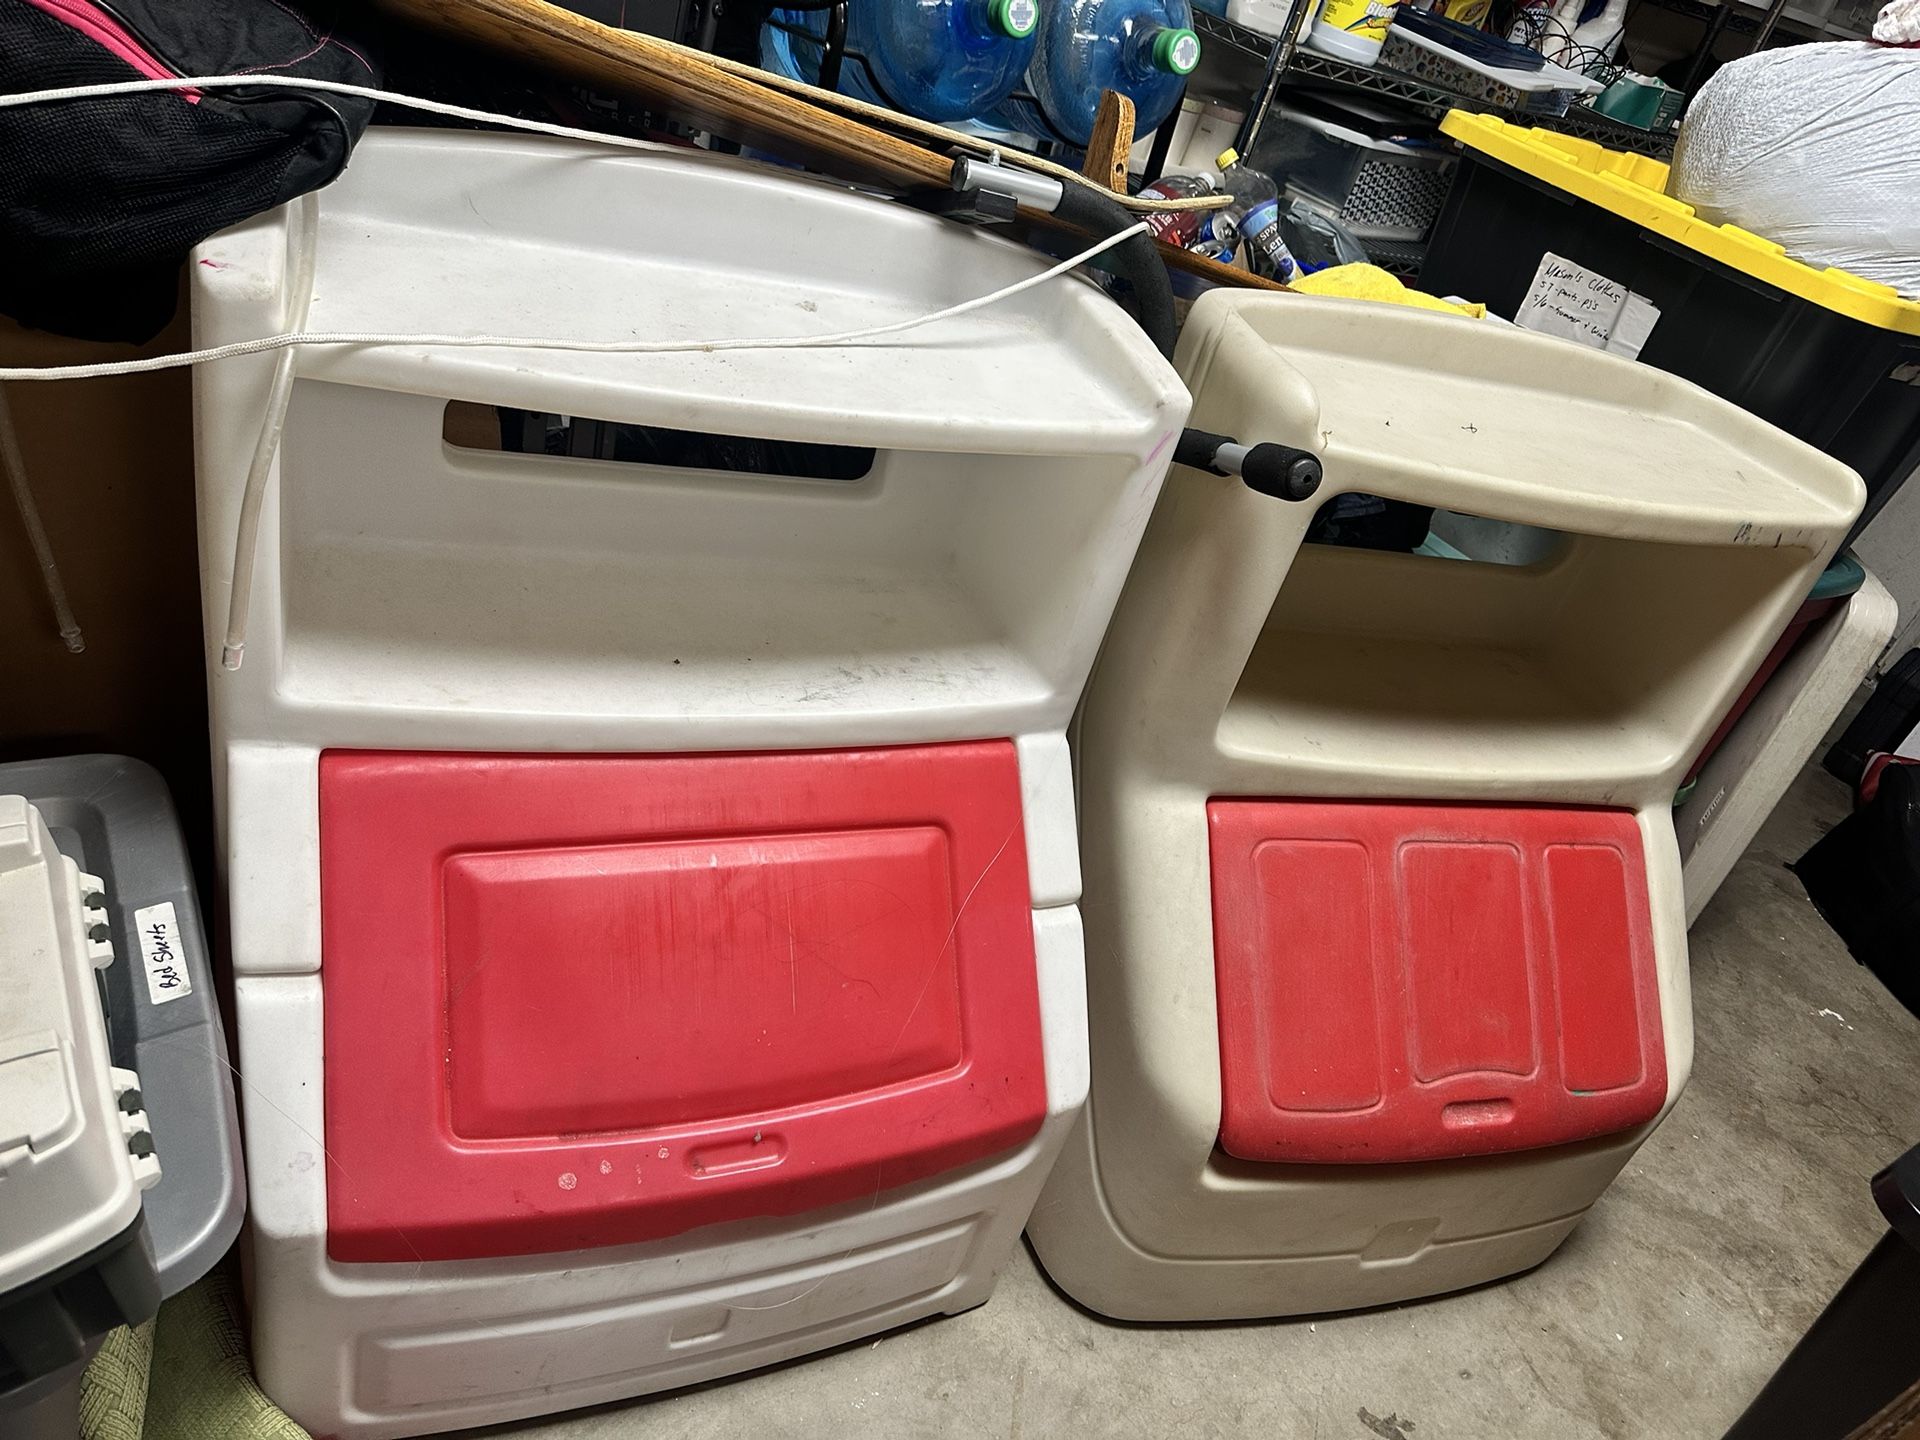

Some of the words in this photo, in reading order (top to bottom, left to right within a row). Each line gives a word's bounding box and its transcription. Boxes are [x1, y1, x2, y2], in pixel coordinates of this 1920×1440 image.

[1544, 262, 1584, 283] Mason's
[1588, 278, 1621, 303] Clothes
[146, 923, 174, 963] Sheets
[153, 966, 181, 988] Bed
